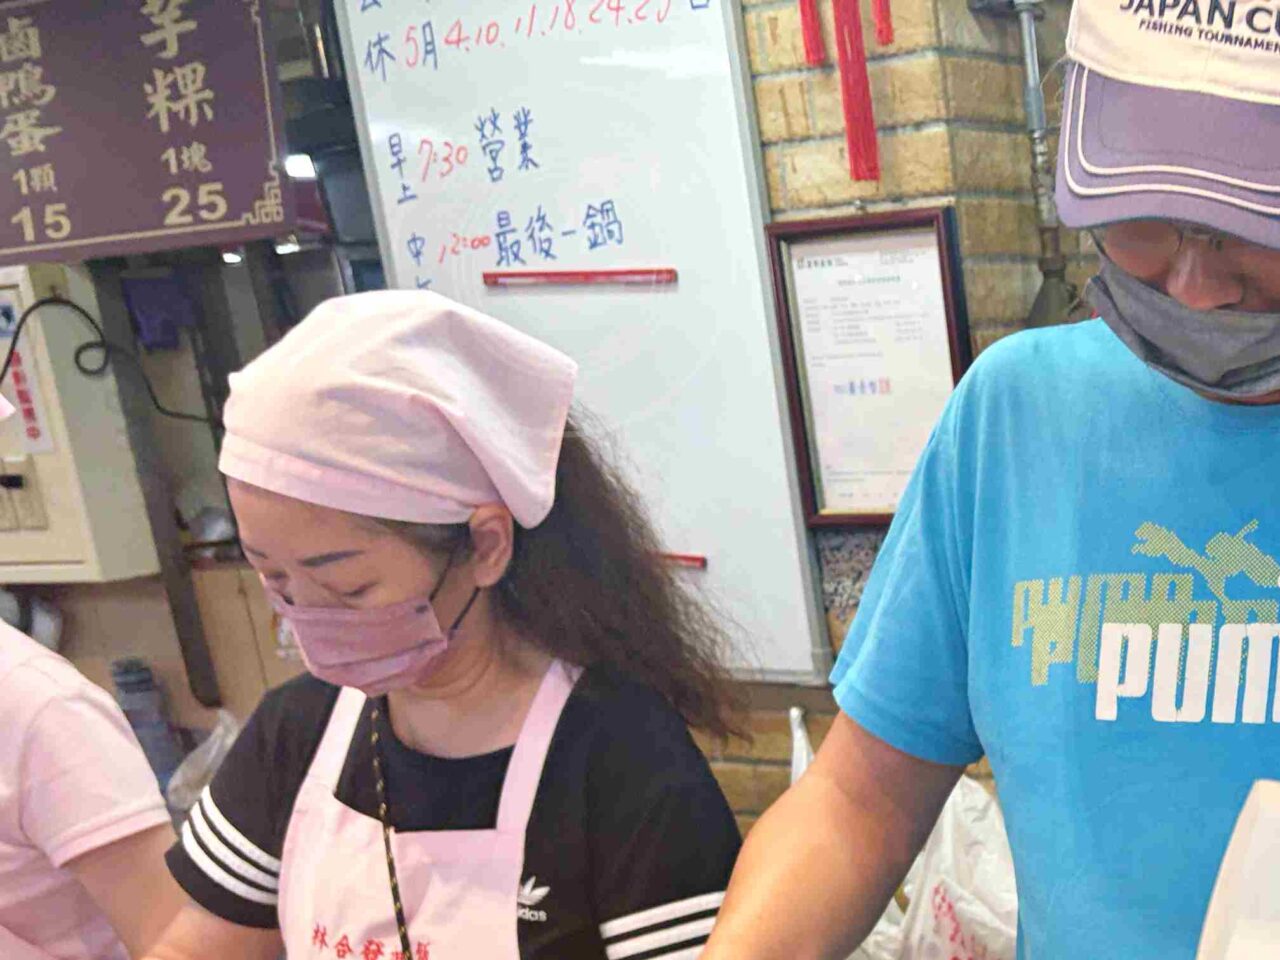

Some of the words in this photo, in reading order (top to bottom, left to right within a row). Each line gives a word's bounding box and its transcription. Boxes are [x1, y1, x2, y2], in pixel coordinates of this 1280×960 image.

[1138, 18, 1194, 38] FISHING
[11, 203, 71, 242] 15
[162, 182, 228, 226] 25
